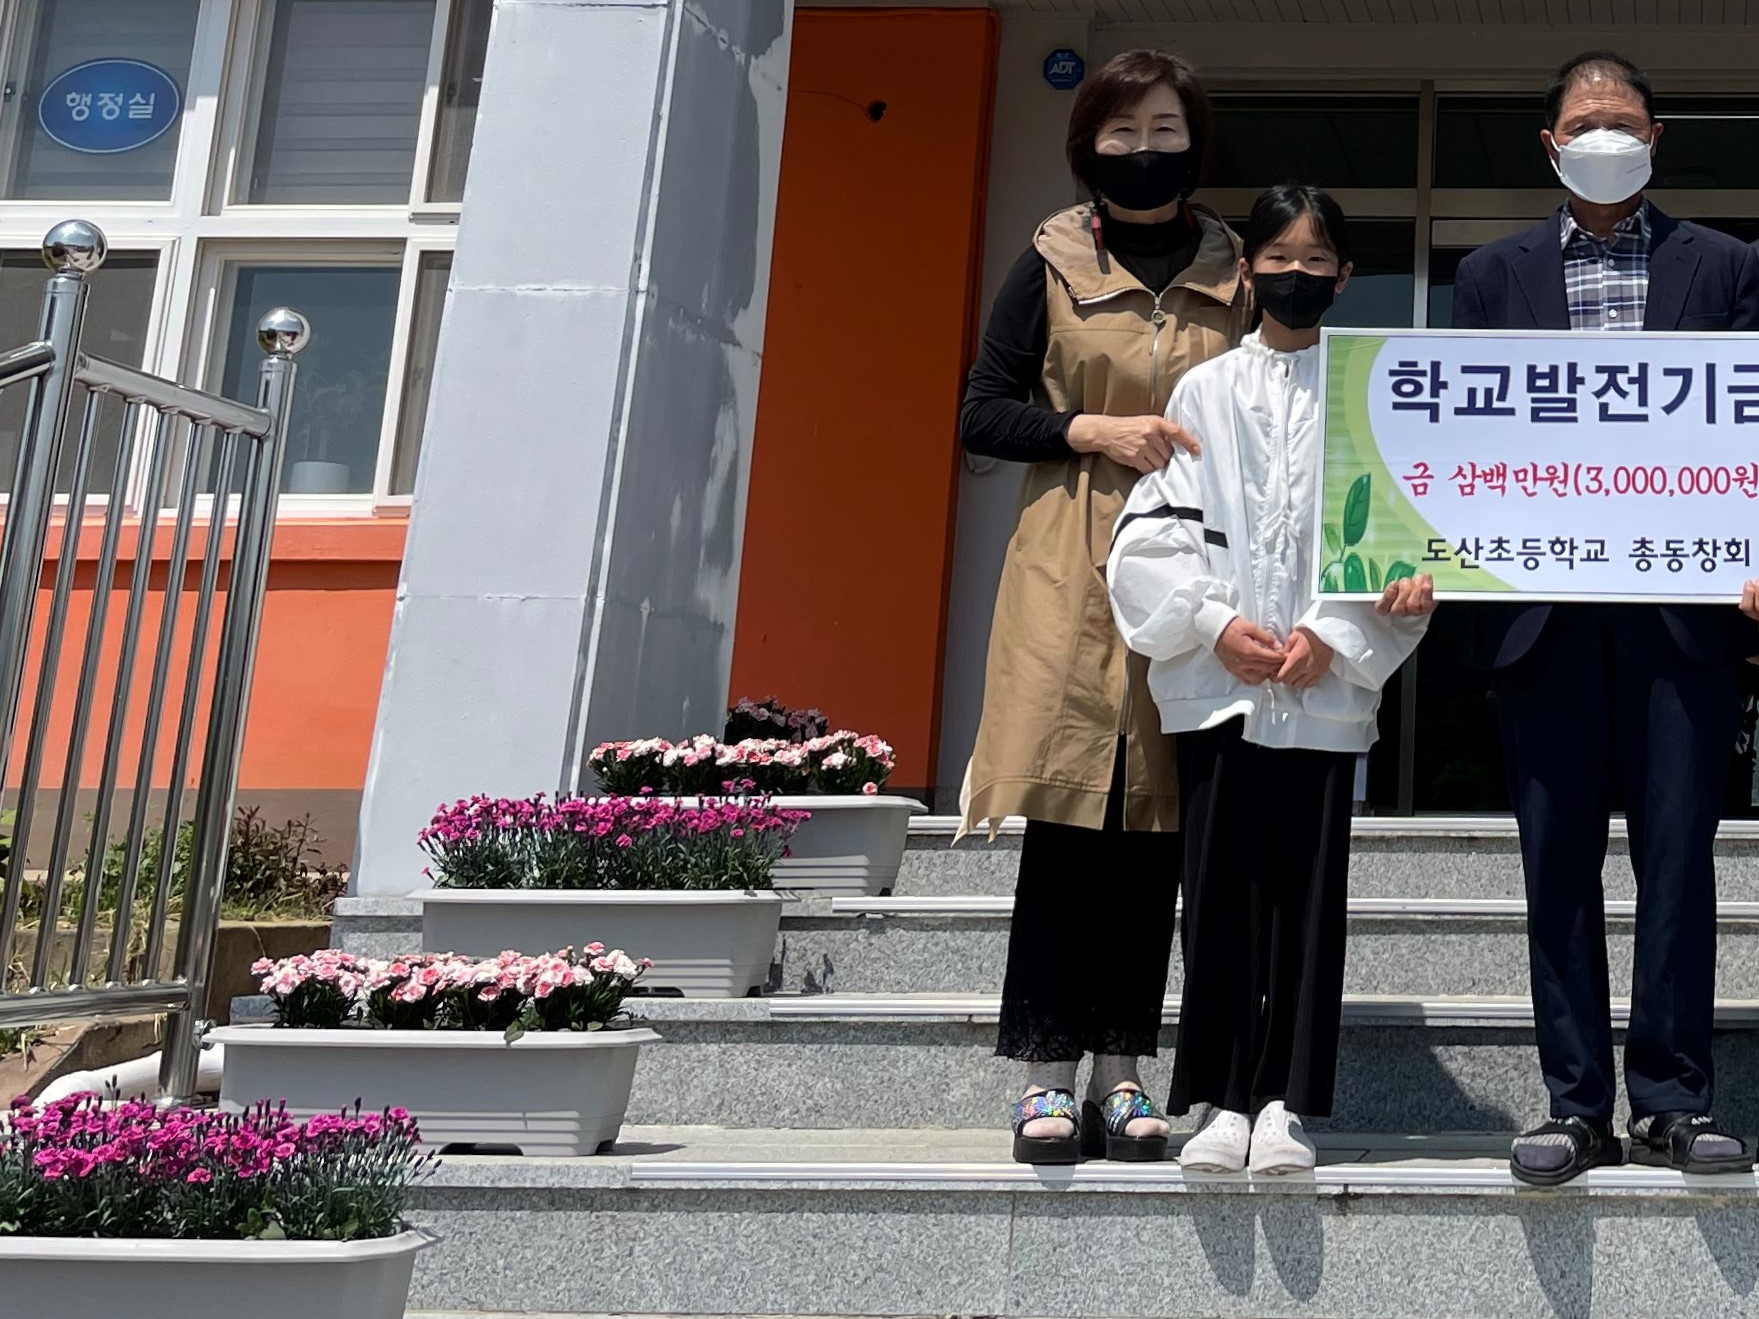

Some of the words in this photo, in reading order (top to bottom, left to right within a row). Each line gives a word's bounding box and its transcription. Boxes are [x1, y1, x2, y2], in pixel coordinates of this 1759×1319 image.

[1049, 62, 1076, 75] ADT
[66, 91, 156, 121] 행정실
[1402, 461, 1436, 498] 금
[1421, 536, 1611, 572] 도산초등학교
[1627, 536, 1751, 573] 총동창회
